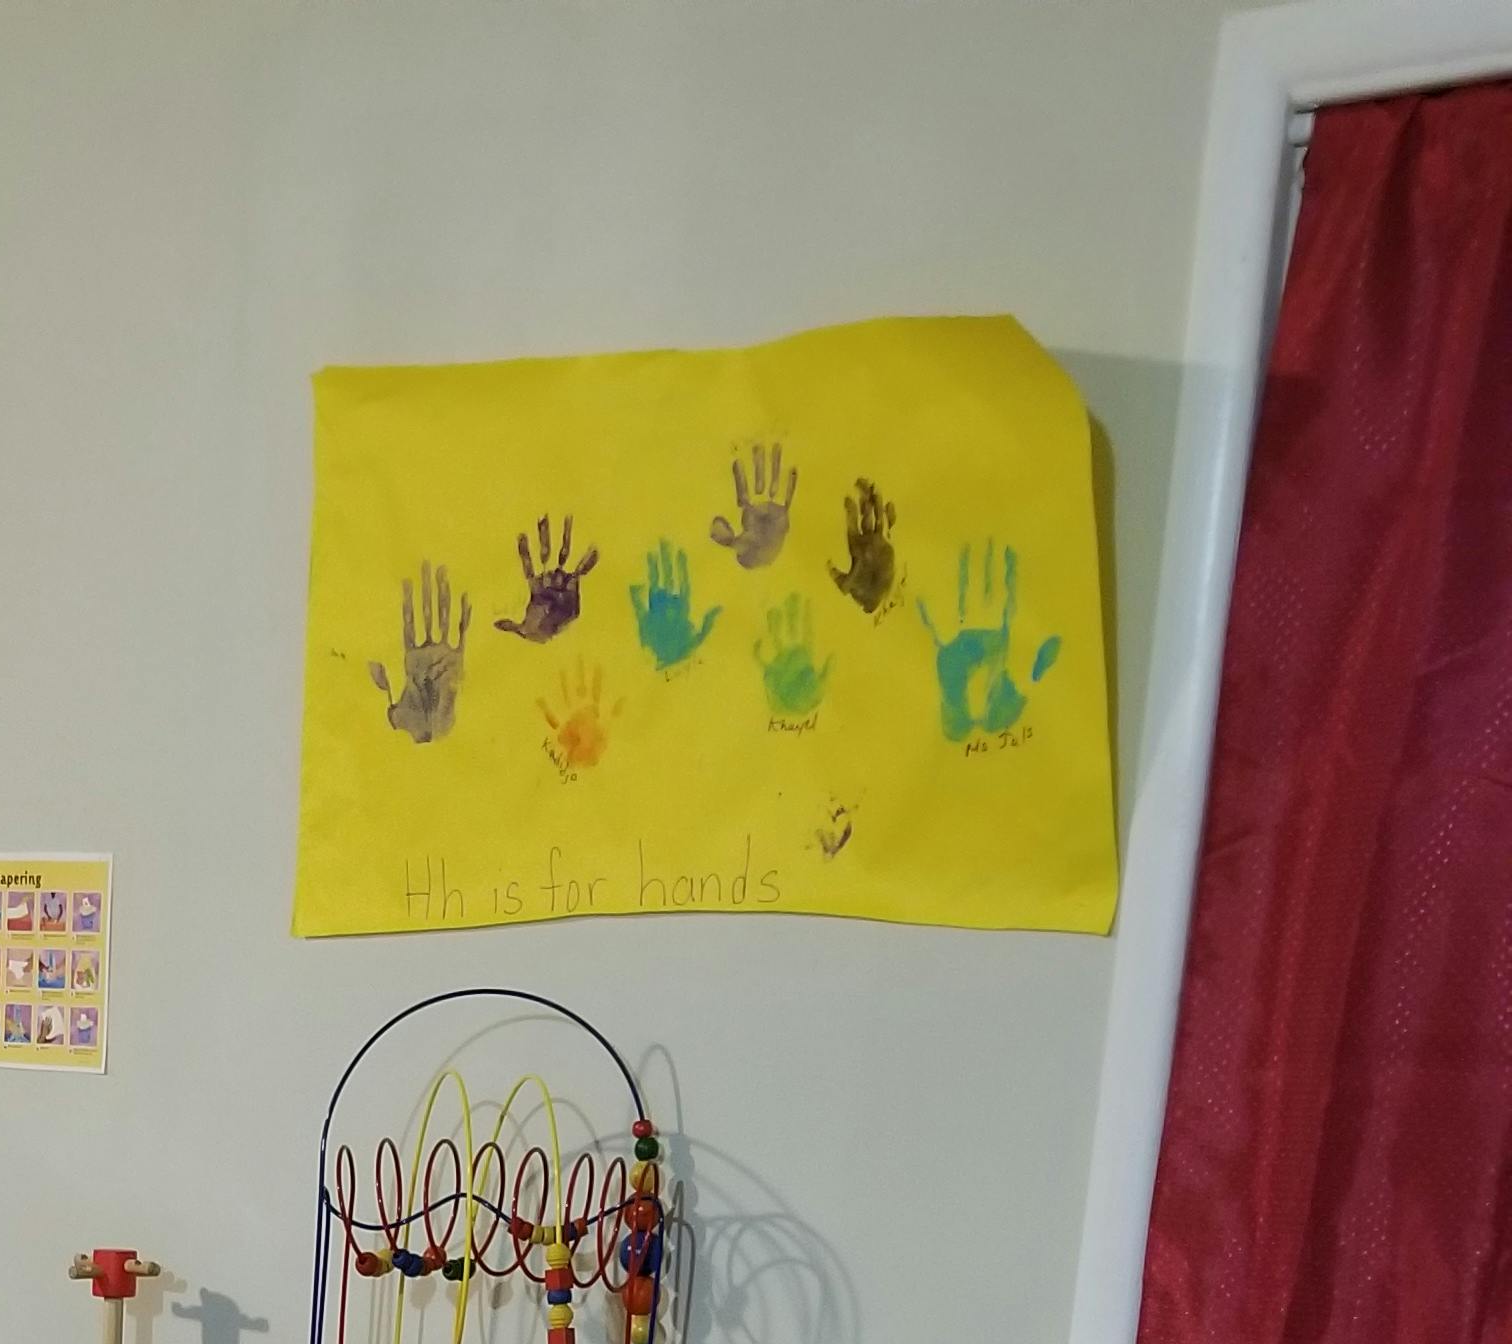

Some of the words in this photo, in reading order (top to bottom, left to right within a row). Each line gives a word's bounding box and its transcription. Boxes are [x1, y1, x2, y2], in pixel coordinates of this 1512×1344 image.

[405, 855, 465, 920] Hh
[493, 868, 525, 916] is
[540, 846, 609, 913] for
[638, 832, 782, 908] hands
